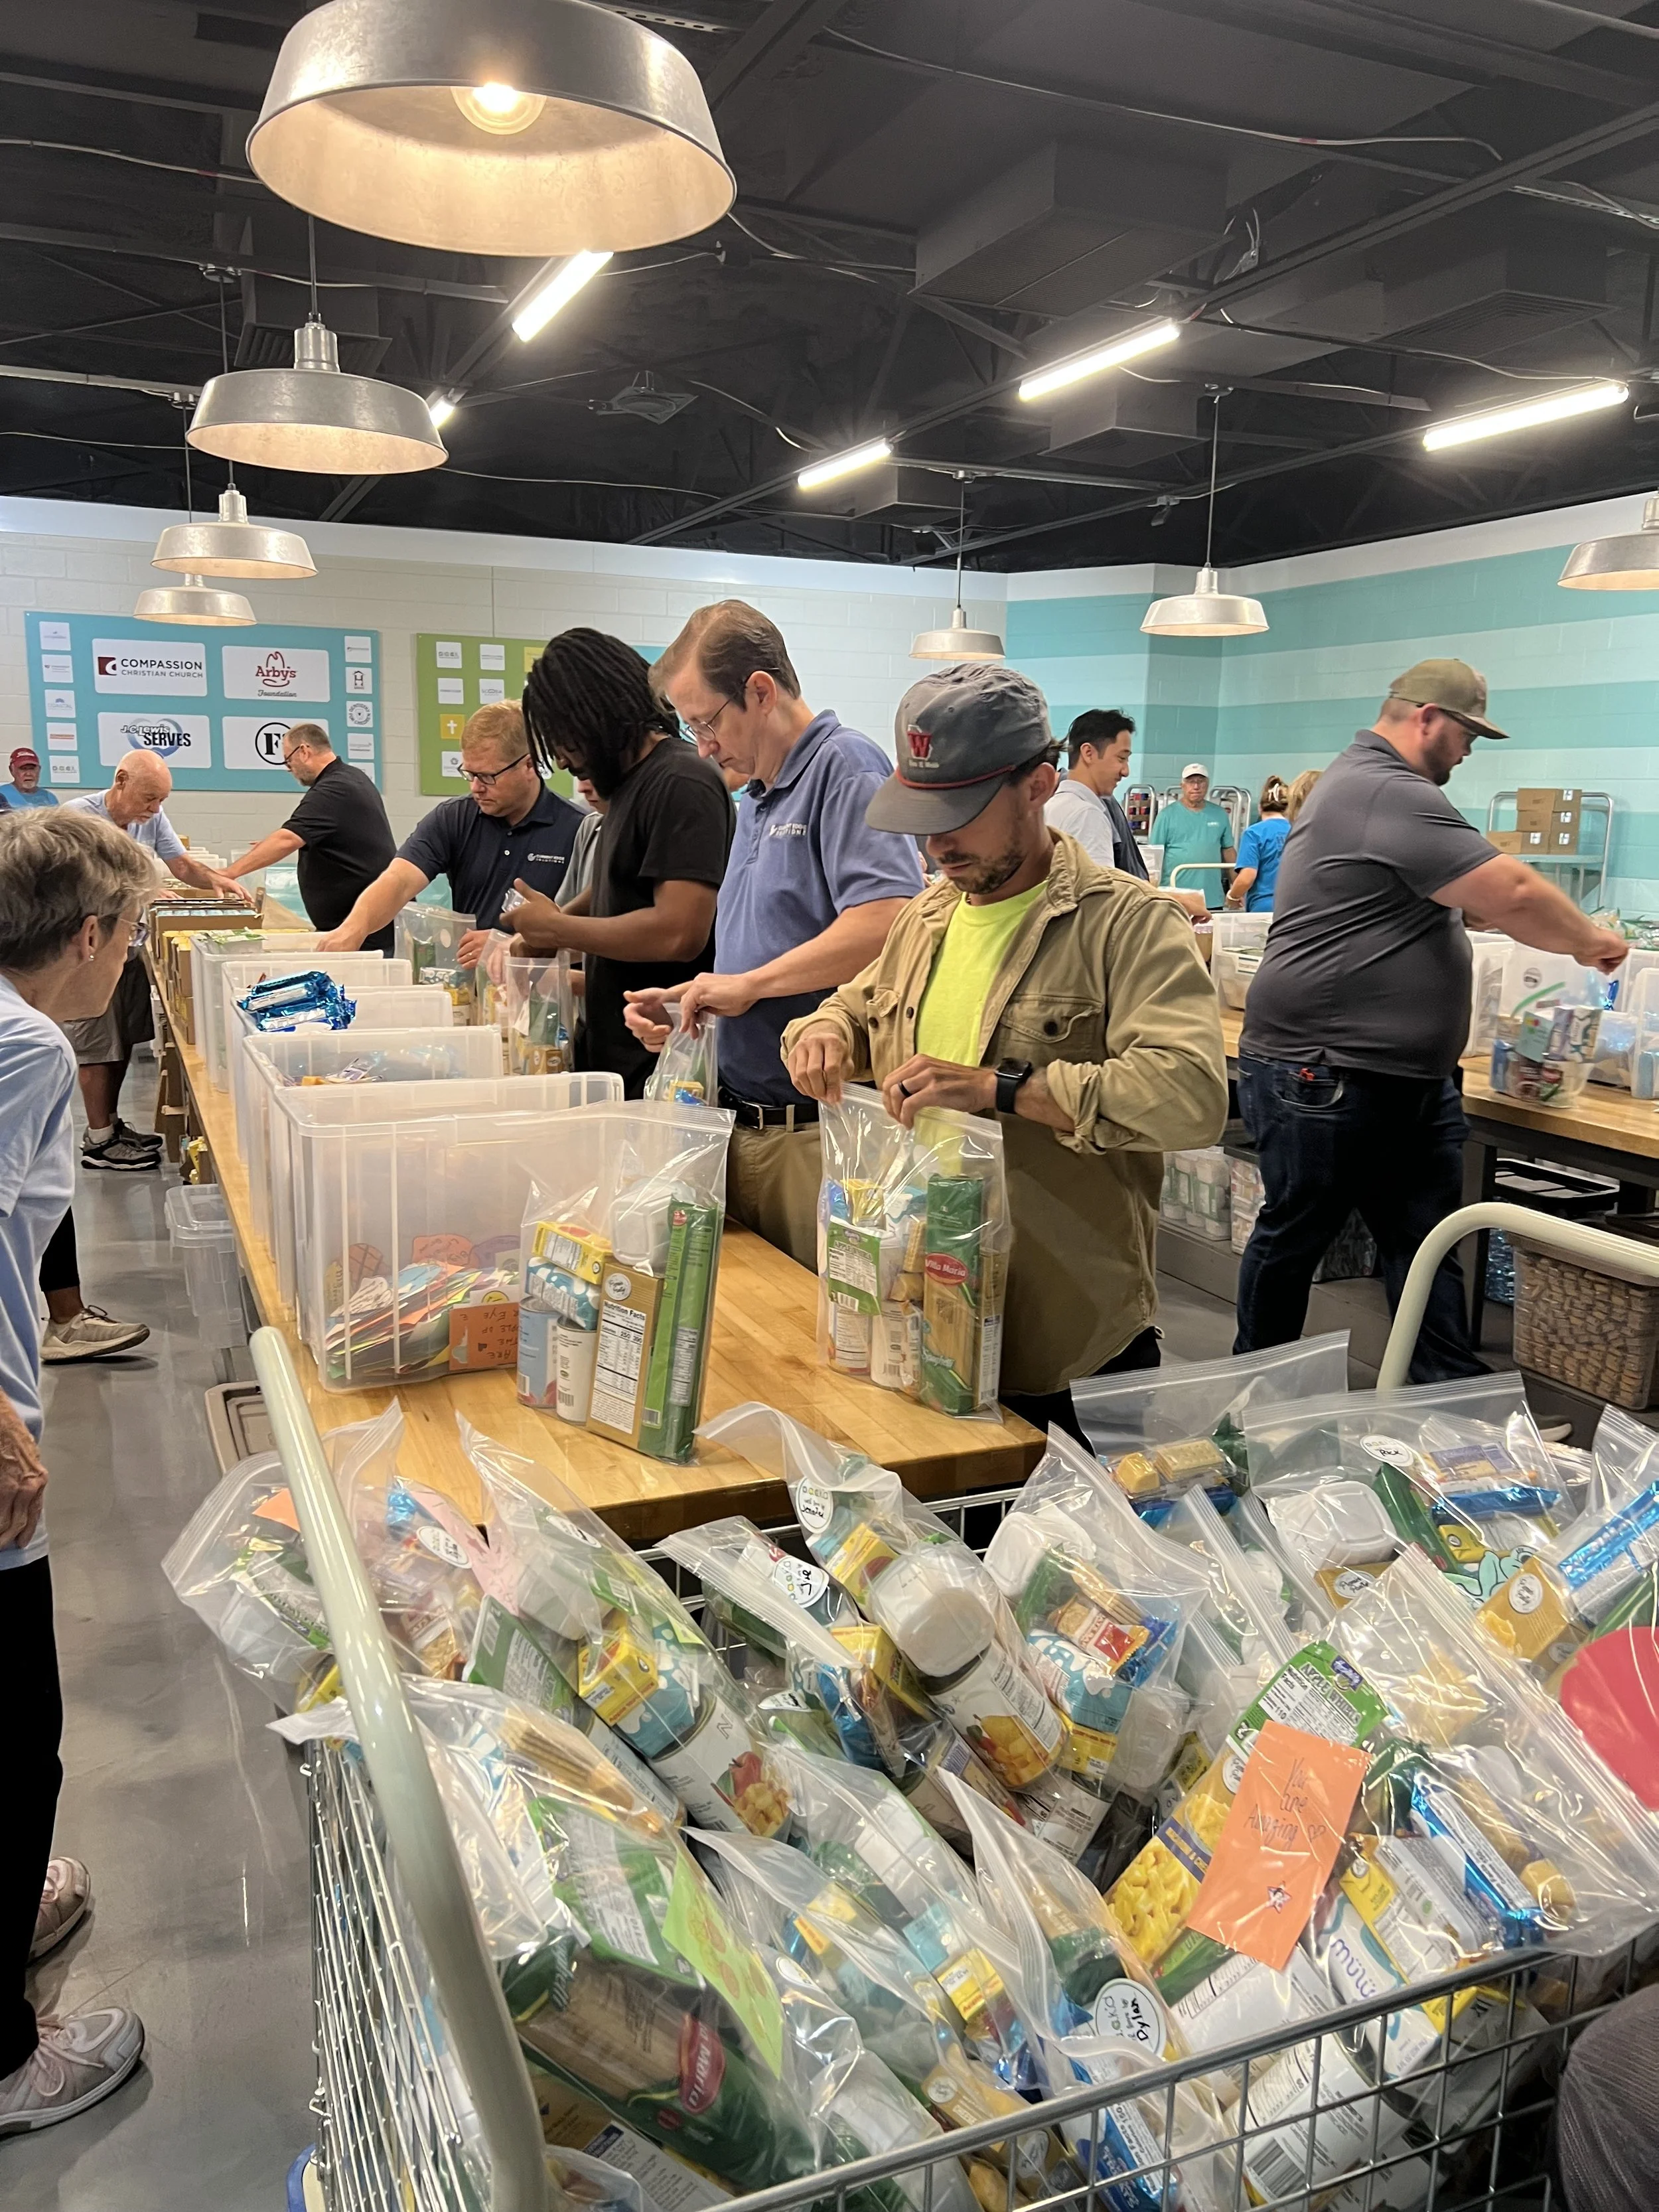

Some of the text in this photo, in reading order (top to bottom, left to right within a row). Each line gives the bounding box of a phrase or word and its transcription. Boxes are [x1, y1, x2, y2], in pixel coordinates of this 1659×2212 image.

[121, 658, 202, 670] COMPASSION
[255, 666, 297, 681] Arby's
[143, 732, 191, 747] SERVES
[942, 1264, 966, 1276] Maria
[604, 1301, 646, 1321] Nutrition Facts
[1300, 1662, 1332, 1694] APPLE
[1131, 1996, 1151, 2041] Dylan
[688, 2042, 711, 2107] Maria
[1116, 2106, 1129, 2124] 150
[1120, 2124, 1137, 2151] Facts
